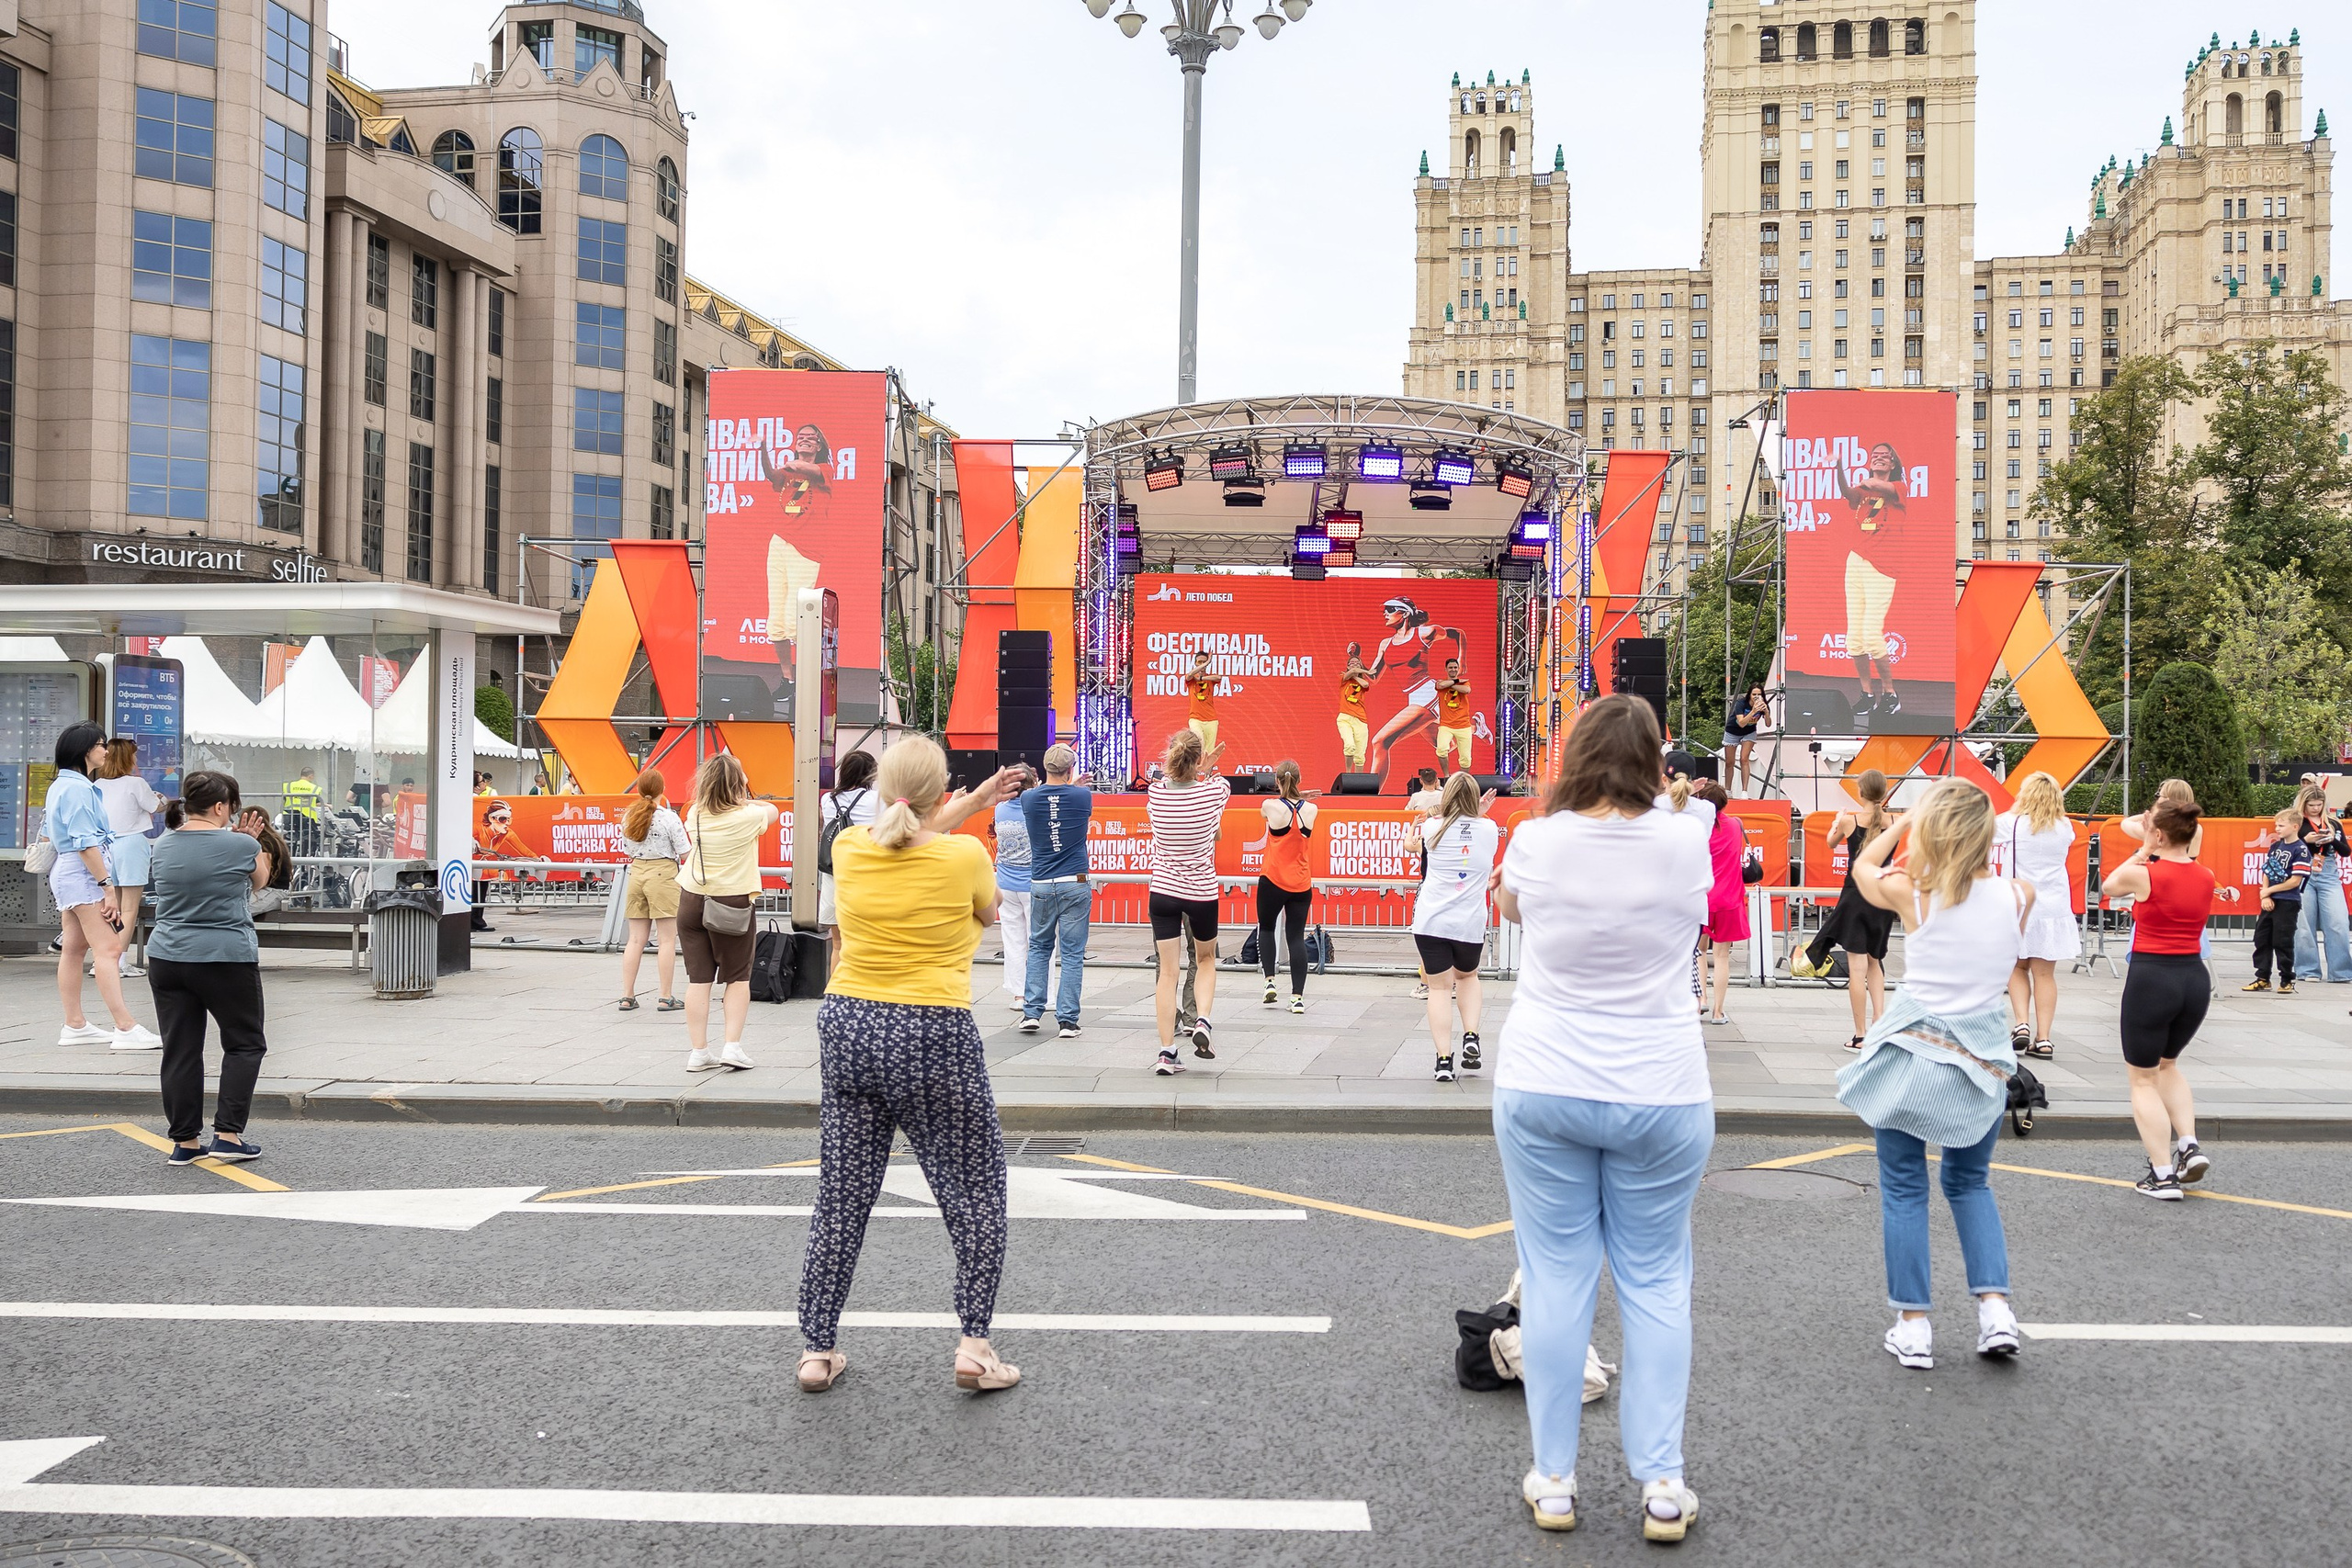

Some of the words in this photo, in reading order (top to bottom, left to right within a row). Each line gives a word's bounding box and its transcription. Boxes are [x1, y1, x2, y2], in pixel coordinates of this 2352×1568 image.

[93, 541, 245, 571] restaurant
[272, 553, 328, 583] selfie
[1185, 592, 1205, 602] ЛЕТО
[1207, 593, 1233, 603] ПОБЕД
[740, 618, 768, 633] ЛЕ
[1147, 632, 1271, 656] ФЕСТИВАЛЬ
[1820, 633, 1847, 649] ЛЕ
[160, 672, 175, 682] ВТБ
[450, 657, 458, 708] площадь
[119, 690, 155, 700] Оформите,
[130, 703, 172, 711] закрутилось
[449, 711, 458, 778] Кудринская
[1047, 795, 1060, 819] Palm
[552, 822, 623, 839] ОЛИМПИЙС
[1048, 821, 1063, 852] Angels
[1105, 828, 1126, 836] ПОБЕД
[553, 839, 607, 853] МОСКВА
[609, 839, 624, 852] 20
[1088, 854, 1126, 871] СКВА
[1130, 854, 1156, 871] 202
[1329, 857, 1404, 875] МОСКВА
